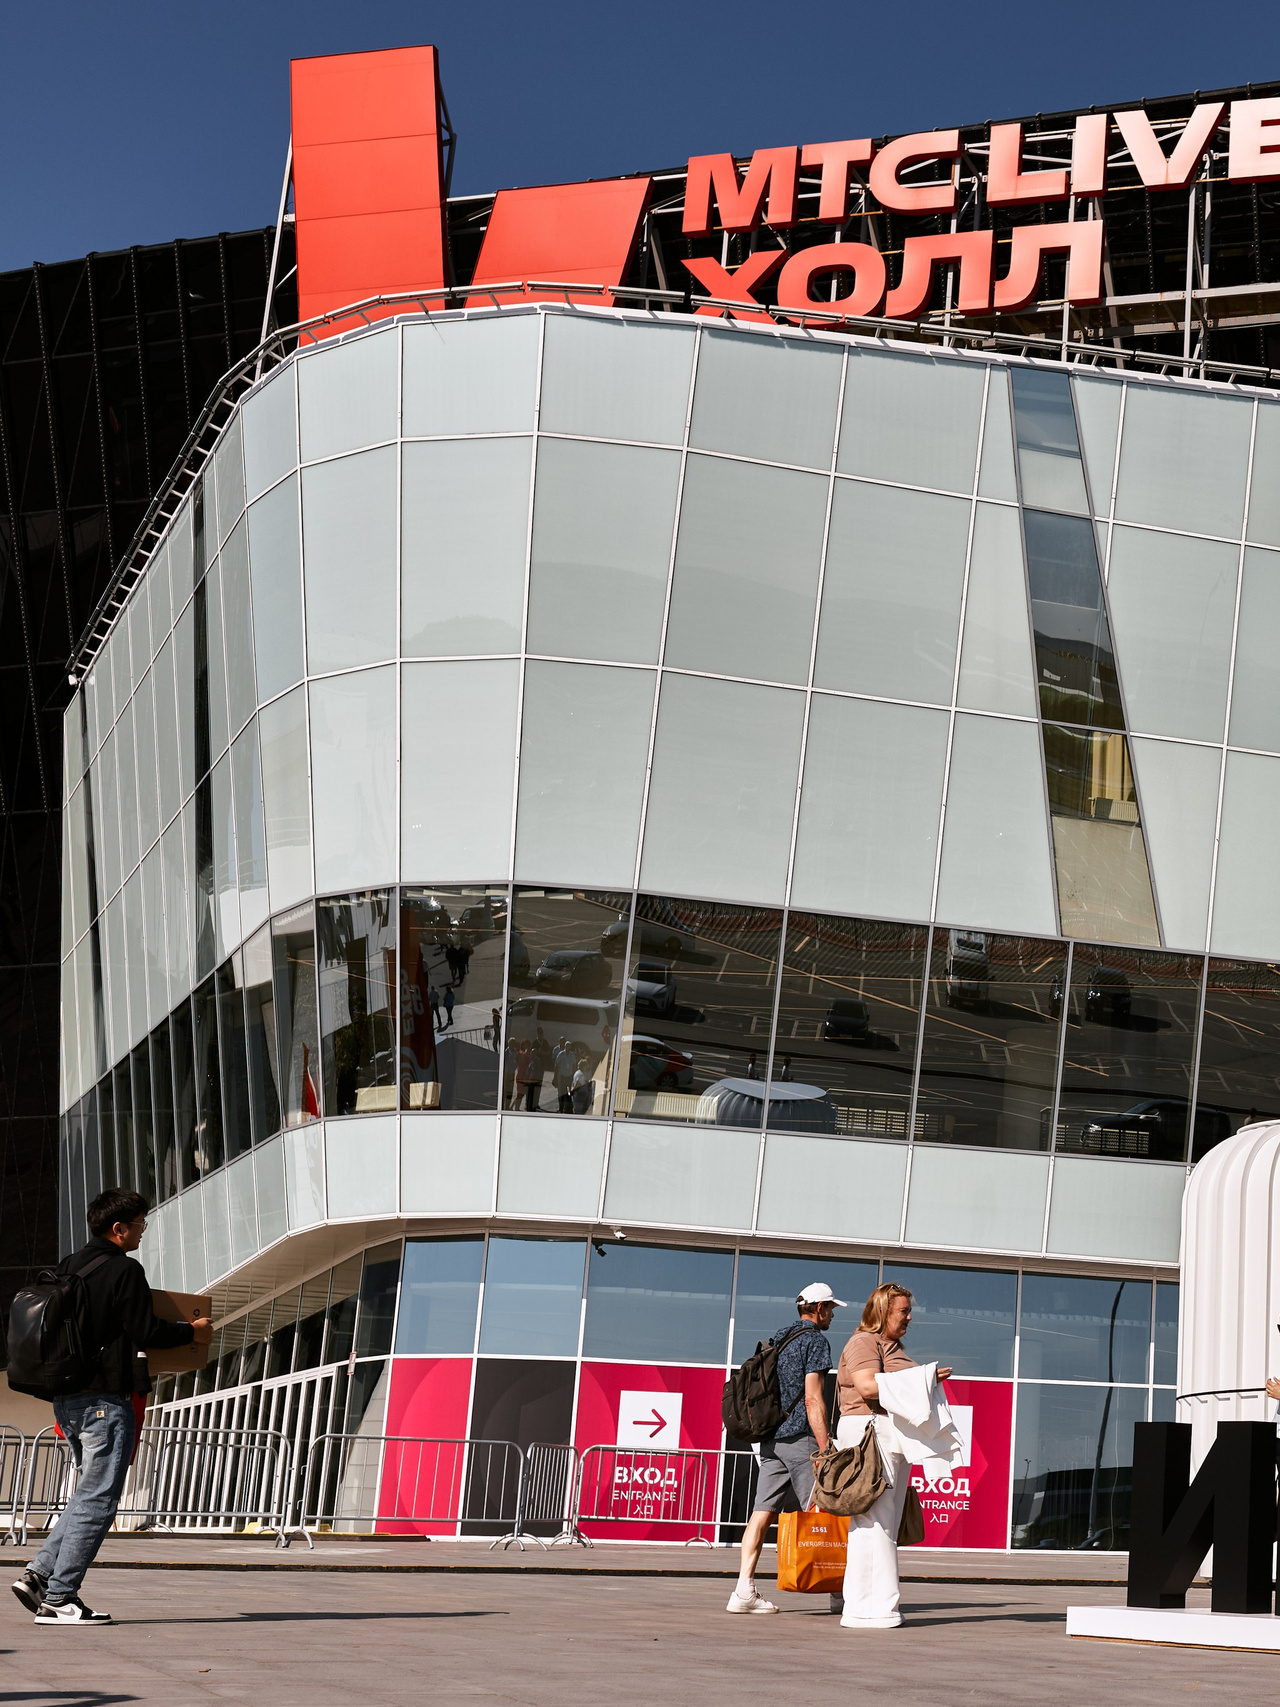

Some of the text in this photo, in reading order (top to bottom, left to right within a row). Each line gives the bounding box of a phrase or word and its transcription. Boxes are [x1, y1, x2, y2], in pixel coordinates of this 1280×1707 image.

[680, 220, 1105, 330] ХОЛЛ
[614, 1466, 678, 1488] ВХОД
[911, 1476, 971, 1497] ВХОД
[613, 1489, 677, 1501] ENTRANCE
[633, 1504, 653, 1515] 入口
[919, 1500, 970, 1510] NTRANCE
[930, 1513, 949, 1523] 入口
